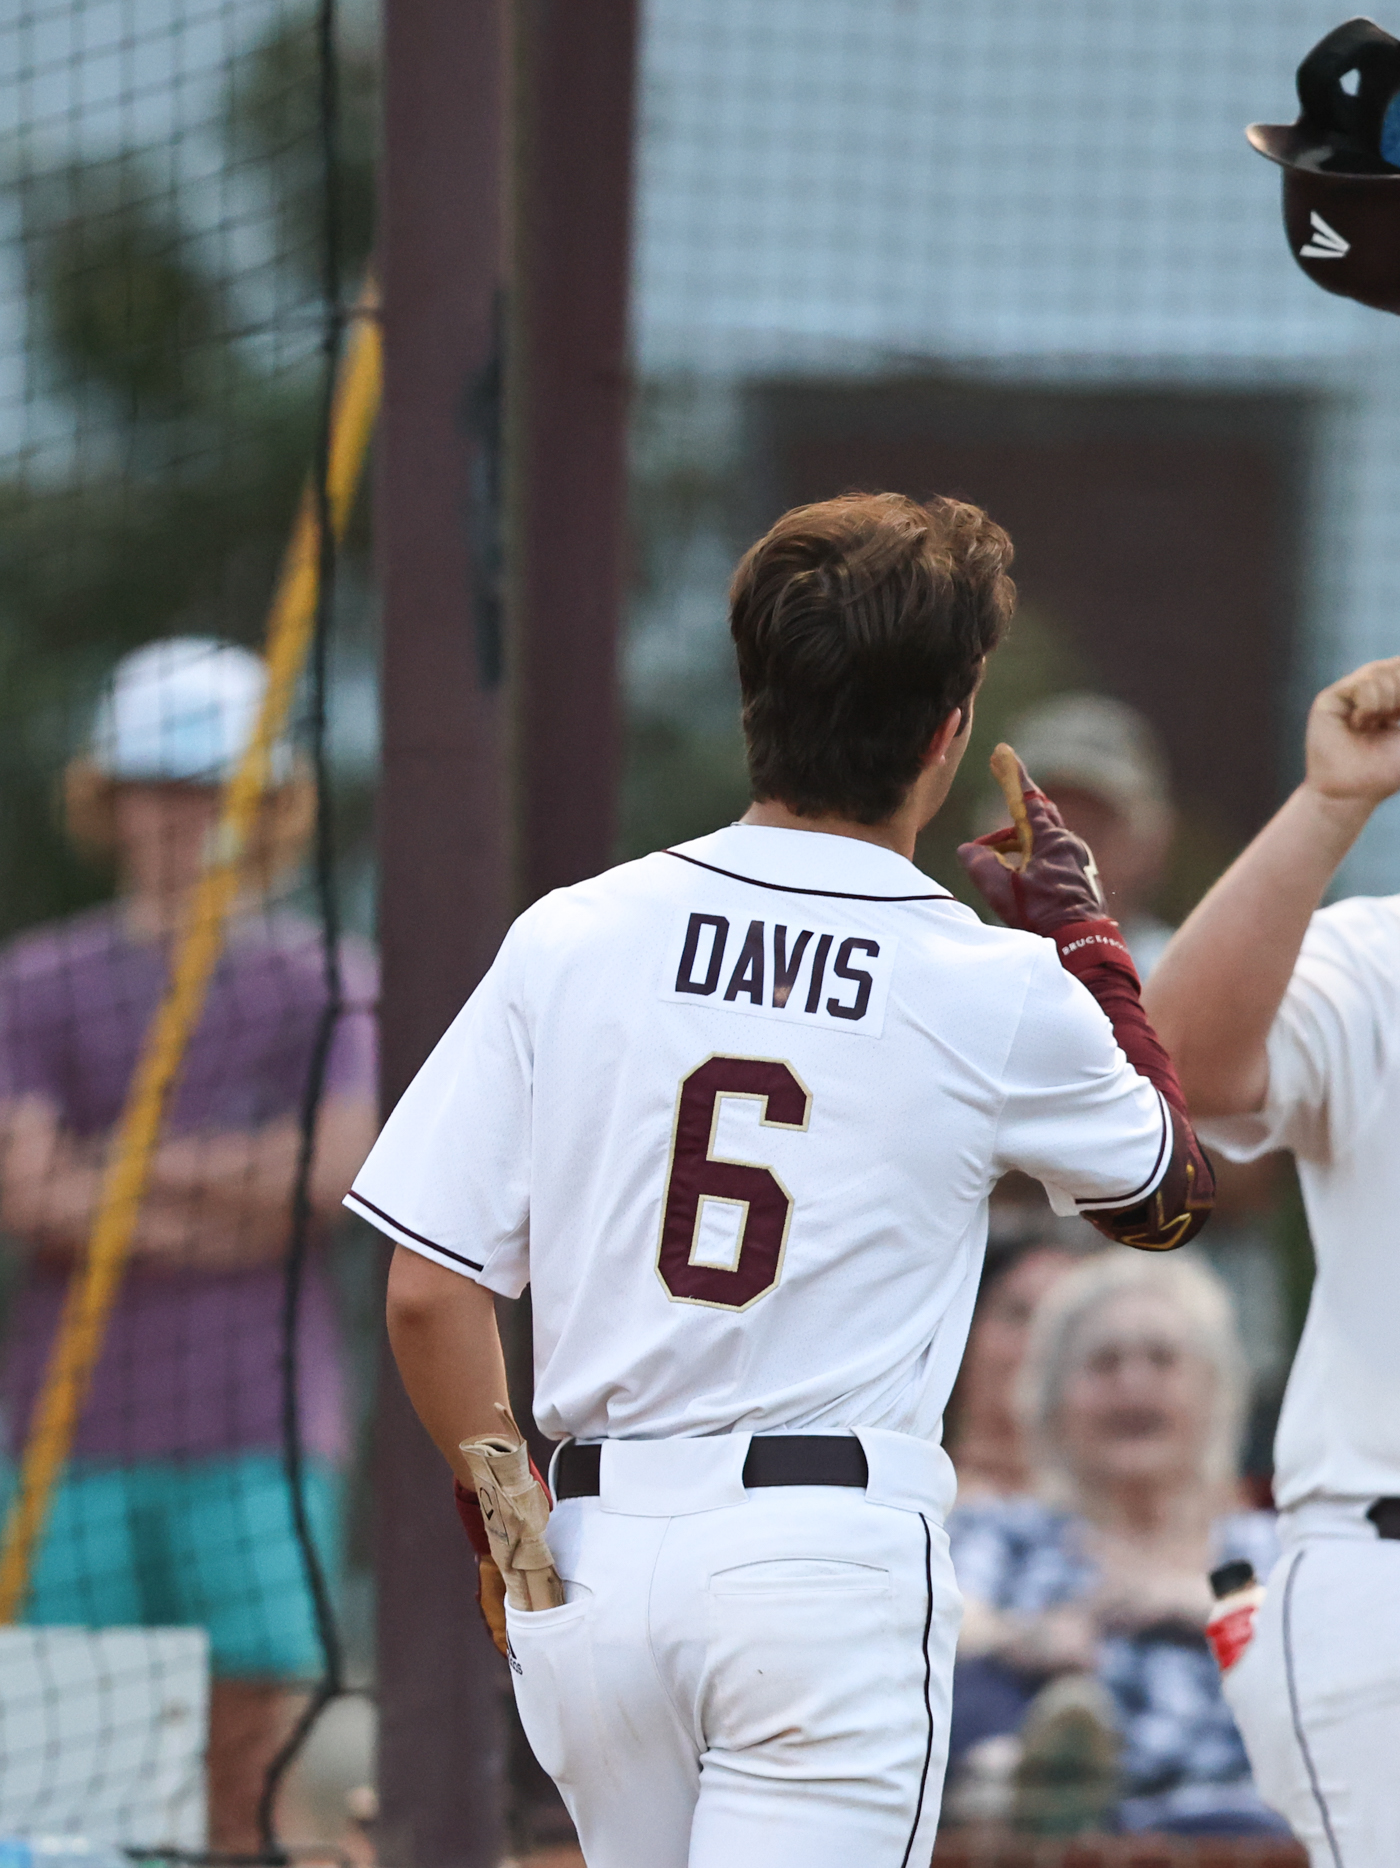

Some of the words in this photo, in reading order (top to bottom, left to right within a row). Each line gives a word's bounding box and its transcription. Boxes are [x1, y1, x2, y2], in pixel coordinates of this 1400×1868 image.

[675, 912, 880, 1021] DAVIS
[1062, 934, 1131, 957] BRUCE
[654, 1051, 813, 1313] 6
